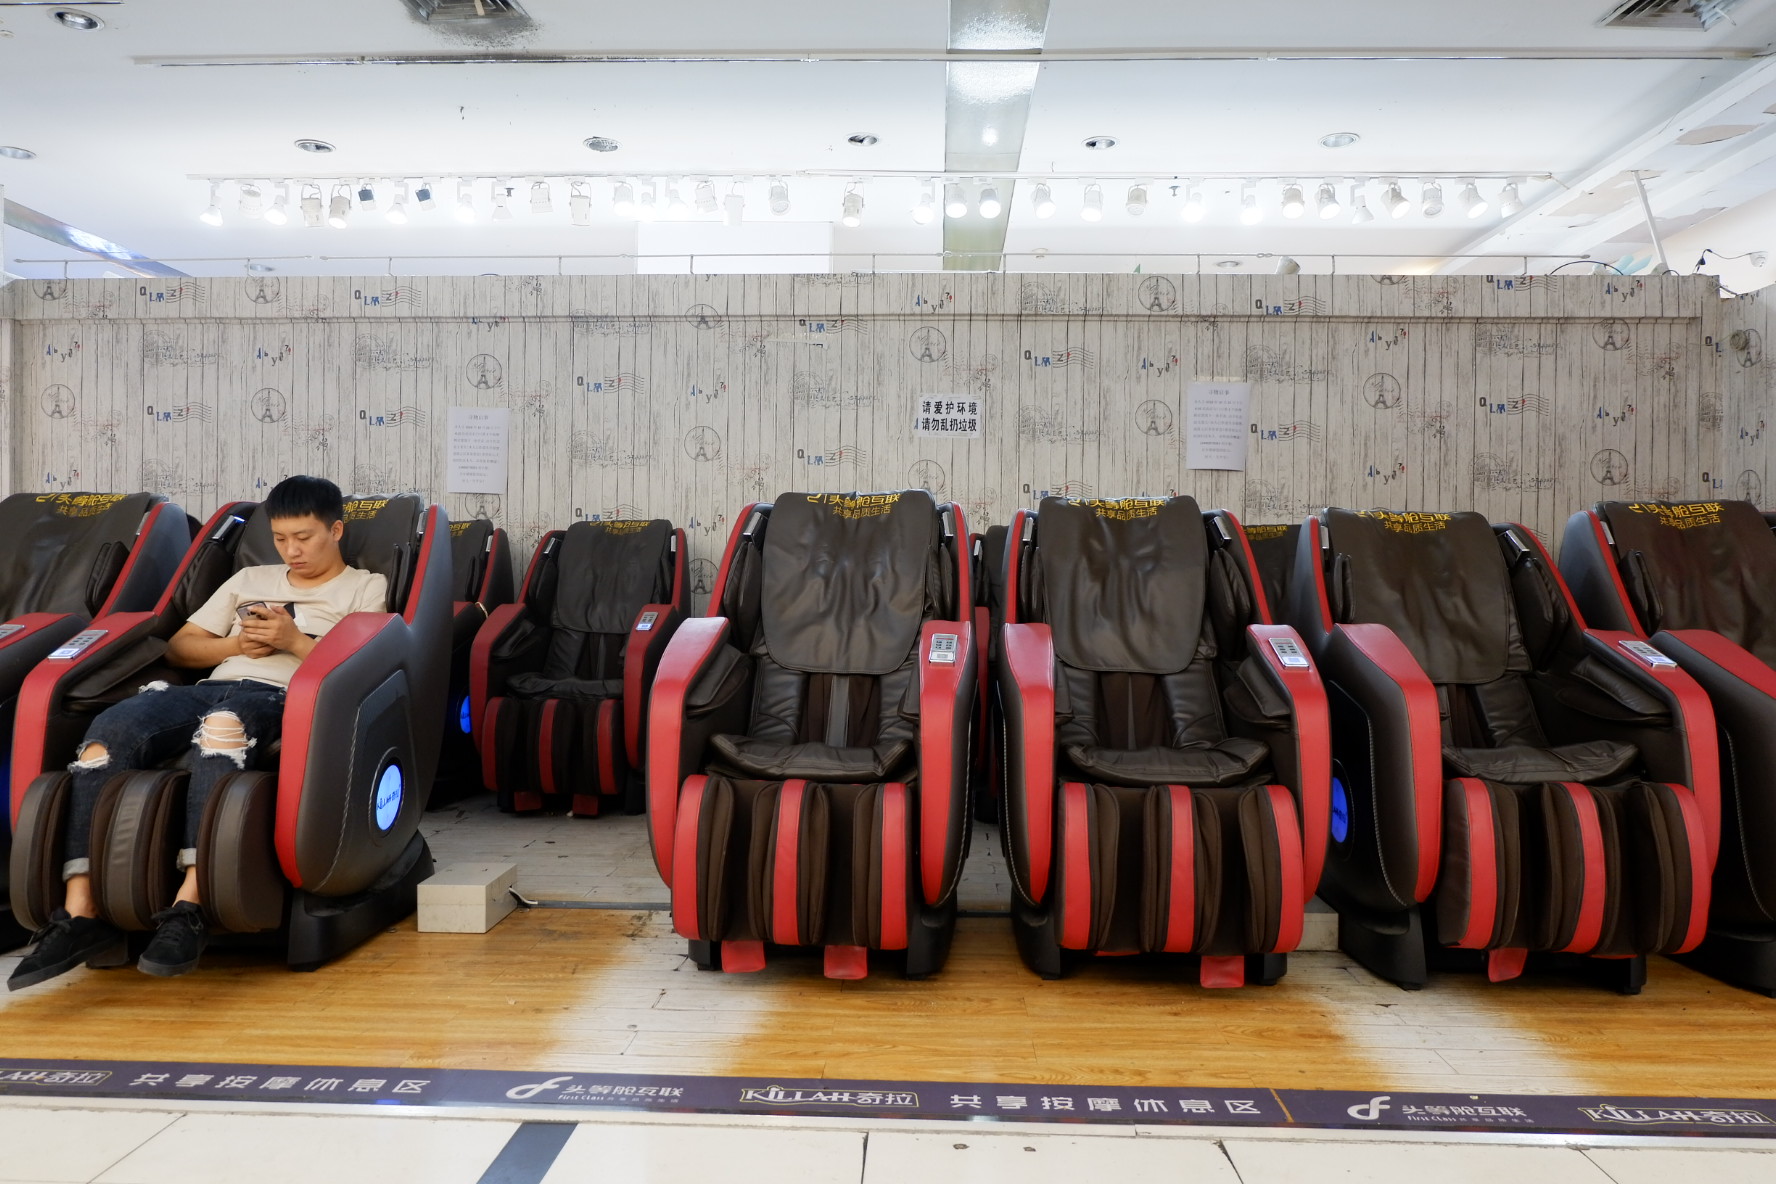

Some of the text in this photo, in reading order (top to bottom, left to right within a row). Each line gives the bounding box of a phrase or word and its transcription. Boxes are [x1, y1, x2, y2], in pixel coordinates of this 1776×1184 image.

[922, 401, 977, 415] 请爱护环境
[922, 417, 977, 431] 请勿乱扔垃圾
[833, 505, 891, 519] 共享品质生活
[1096, 507, 1157, 520] 共享品质生活
[128, 1073, 431, 1094] 共享按摩休息区
[950, 1094, 1261, 1114] 共享按摩休息区
